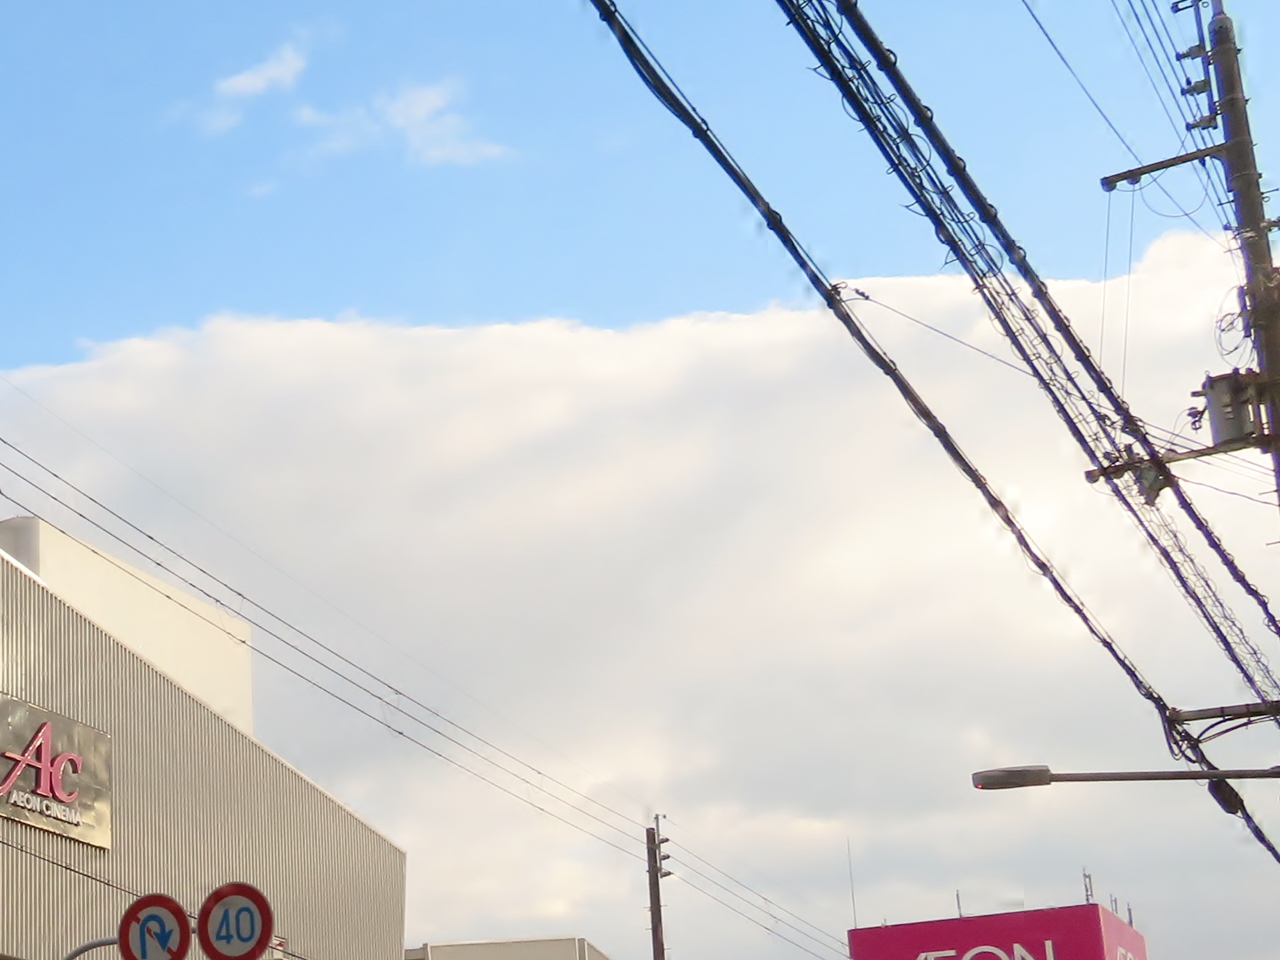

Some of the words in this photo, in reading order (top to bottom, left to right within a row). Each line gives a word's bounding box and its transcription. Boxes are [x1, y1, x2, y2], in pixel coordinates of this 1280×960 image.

[11, 789, 40, 812] AEON
[43, 800, 82, 826] CINEMA
[215, 906, 255, 945] 40
